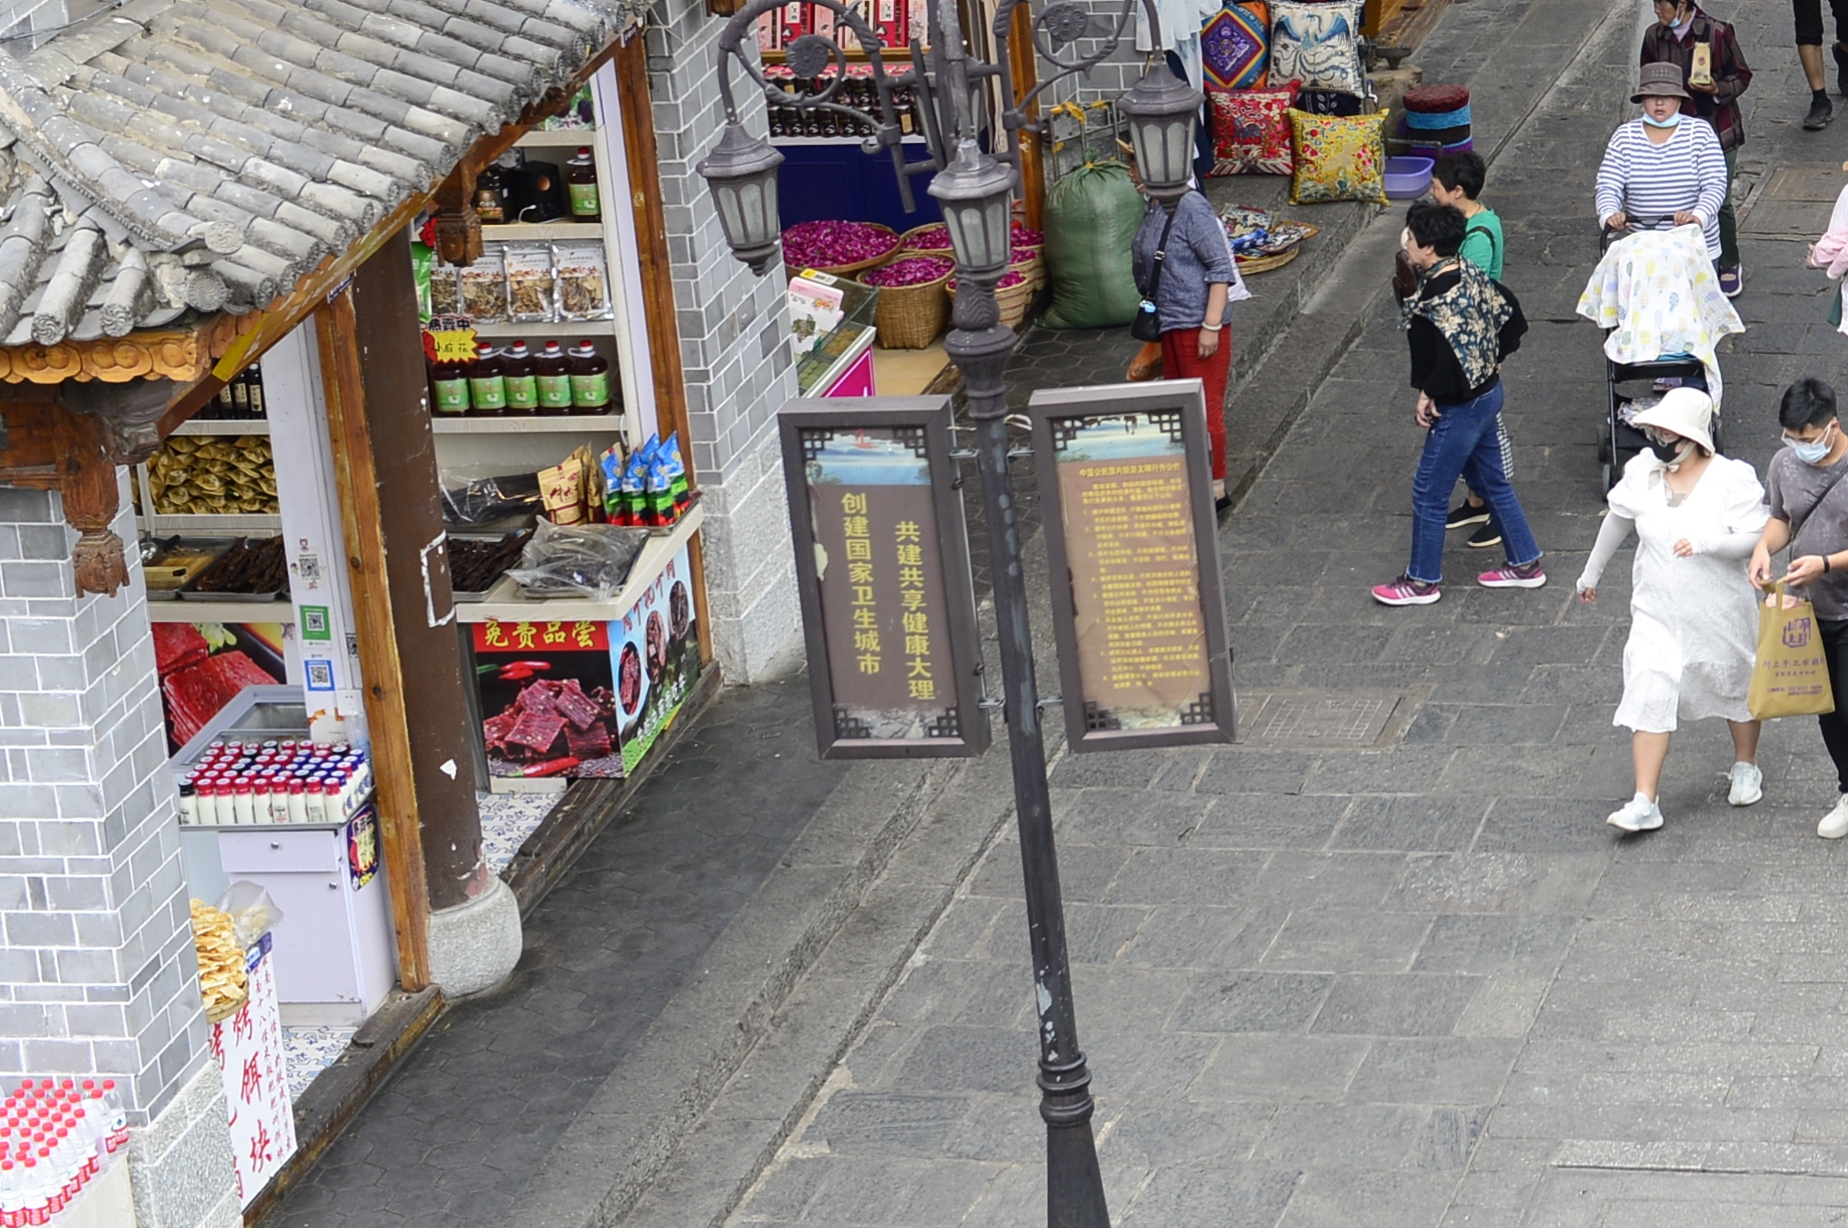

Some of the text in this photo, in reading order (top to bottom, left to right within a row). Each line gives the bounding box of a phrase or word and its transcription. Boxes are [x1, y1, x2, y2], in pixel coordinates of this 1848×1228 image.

[484, 620, 597, 649] 免费品尝
[841, 492, 881, 675] 创建国家卫生城市
[895, 521, 936, 701] 共建共享健康大理
